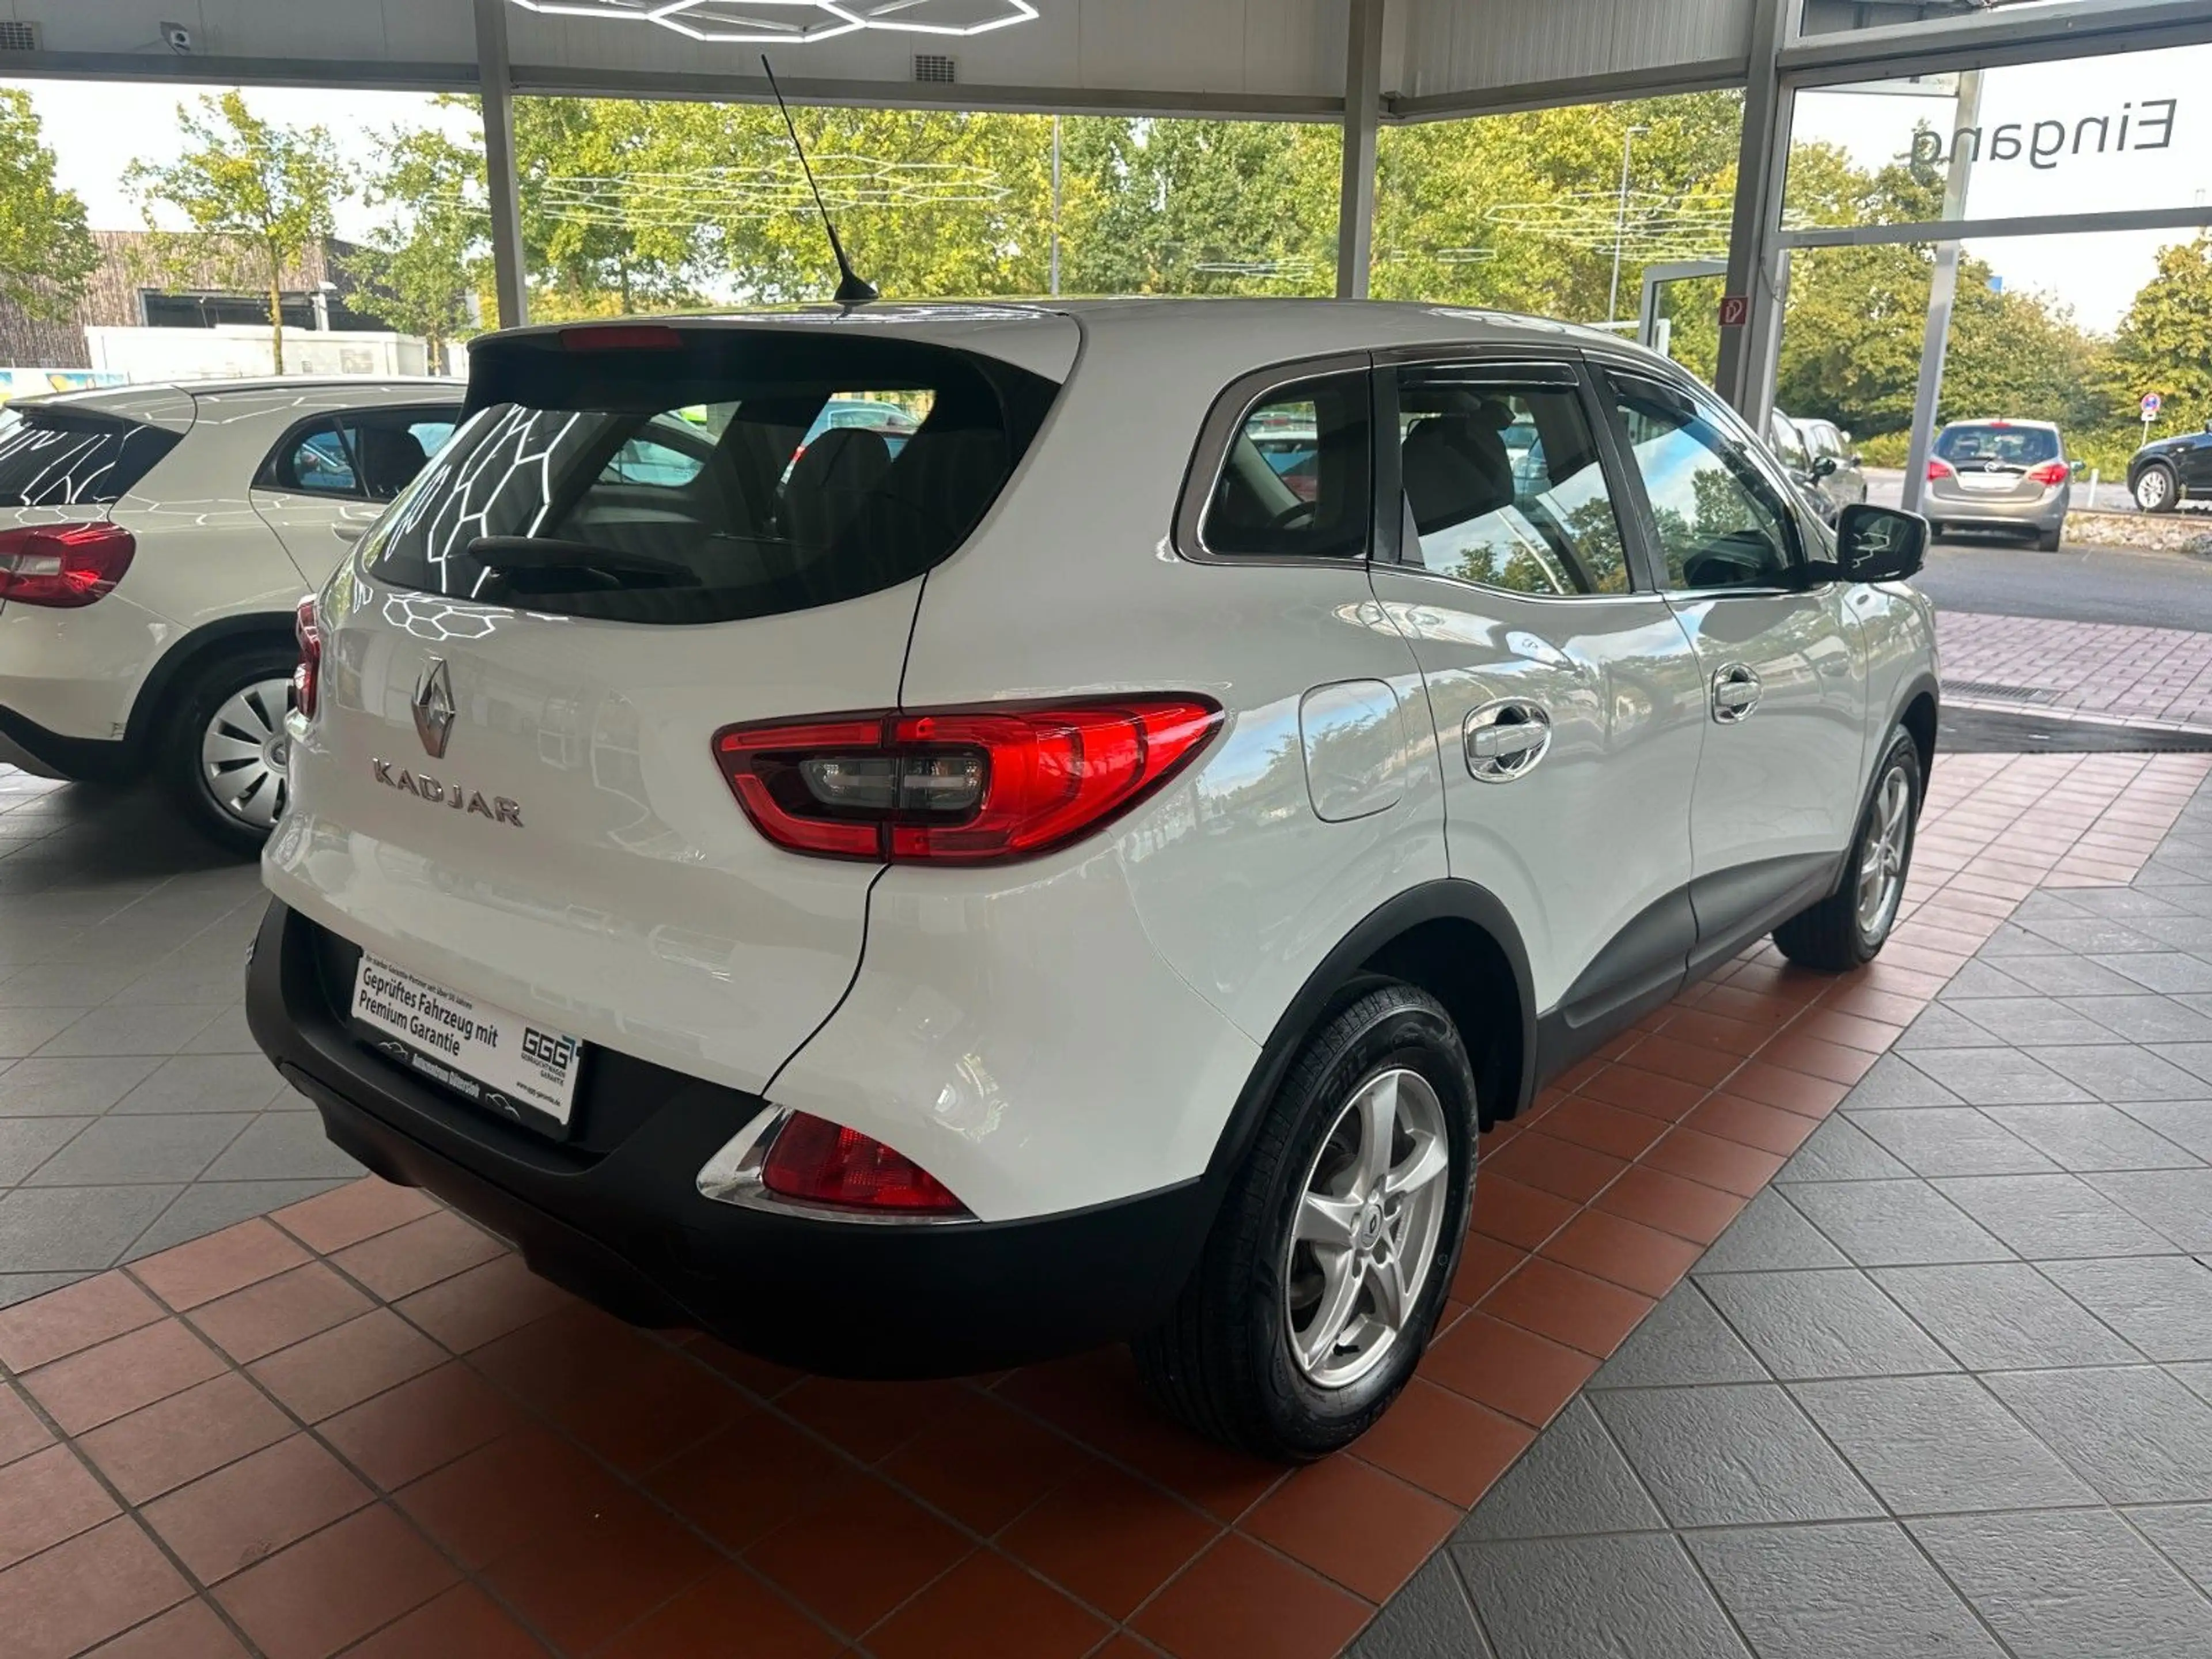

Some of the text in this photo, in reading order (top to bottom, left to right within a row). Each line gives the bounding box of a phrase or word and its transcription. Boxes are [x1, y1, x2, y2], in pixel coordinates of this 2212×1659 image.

[373, 757, 524, 828] KADJAR
[359, 990, 460, 1056] Premium Garantie
[363, 967, 498, 1048] Geprüftes Fahrzeug mit
[522, 1027, 571, 1070] GGG
